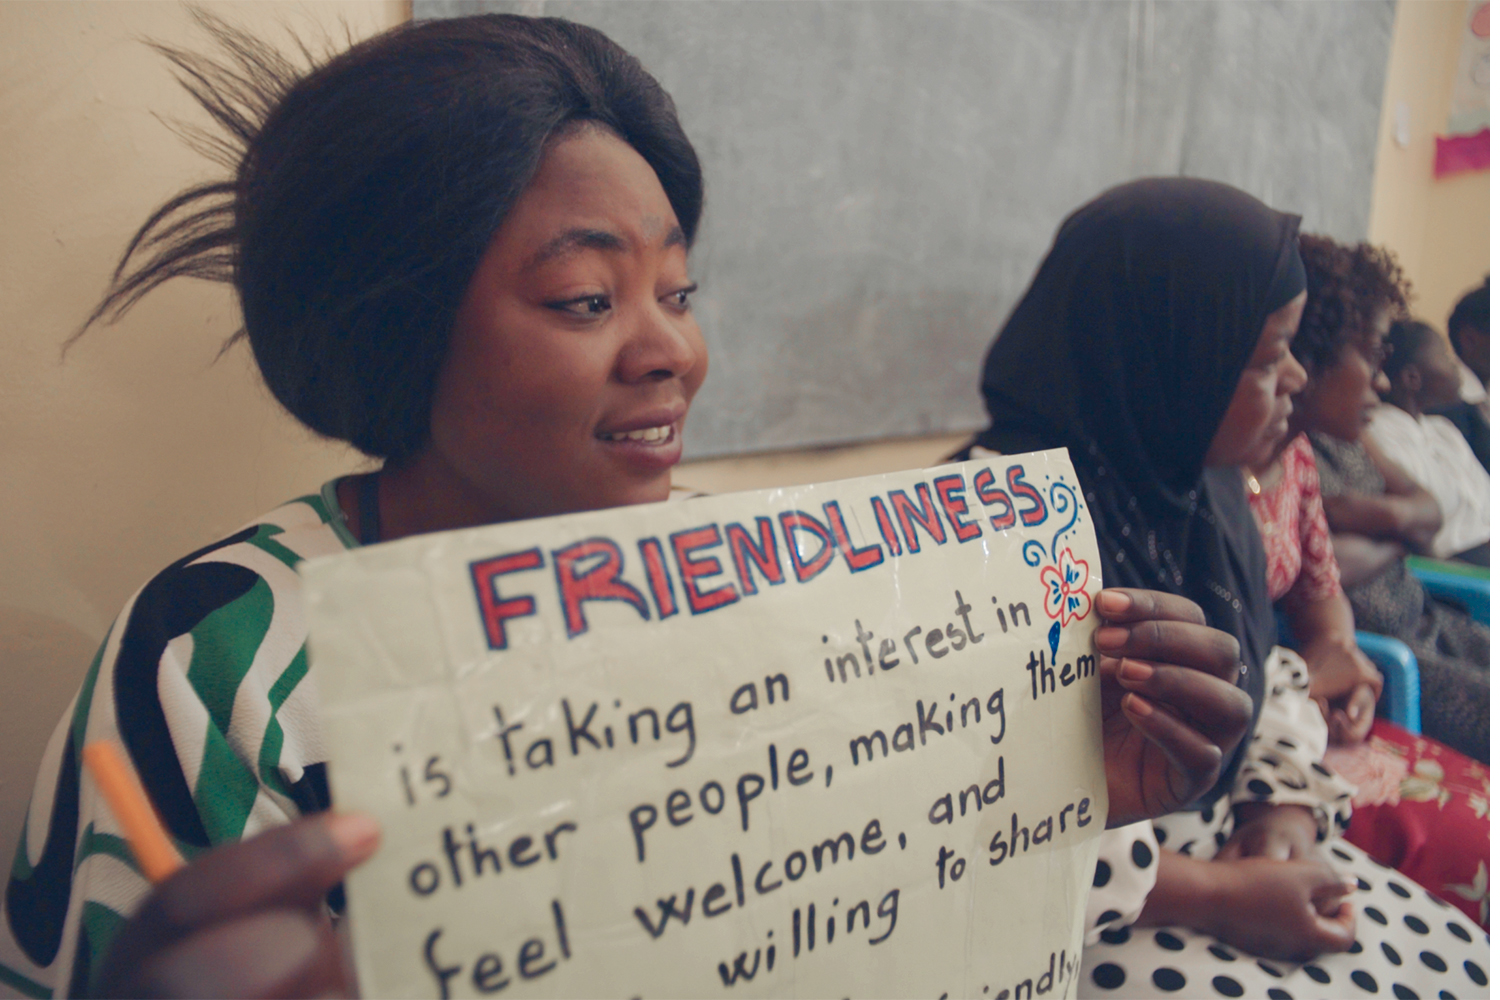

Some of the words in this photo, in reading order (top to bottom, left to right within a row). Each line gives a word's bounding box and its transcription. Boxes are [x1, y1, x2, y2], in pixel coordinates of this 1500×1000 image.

[468, 464, 1049, 651] FRIENDLINESS
[394, 744, 452, 806] is
[492, 697, 697, 776] taking
[730, 672, 790, 718] an
[821, 588, 985, 684] interest
[991, 596, 1031, 633] in
[408, 822, 577, 897] other
[629, 743, 834, 863] people,
[849, 687, 1006, 767] making
[1026, 649, 1096, 701] them
[422, 899, 571, 1000] feel
[633, 818, 907, 939] welcome,
[928, 755, 1006, 826] and
[717, 888, 900, 988] willing
[936, 845, 966, 890] to
[988, 797, 1092, 867] share
